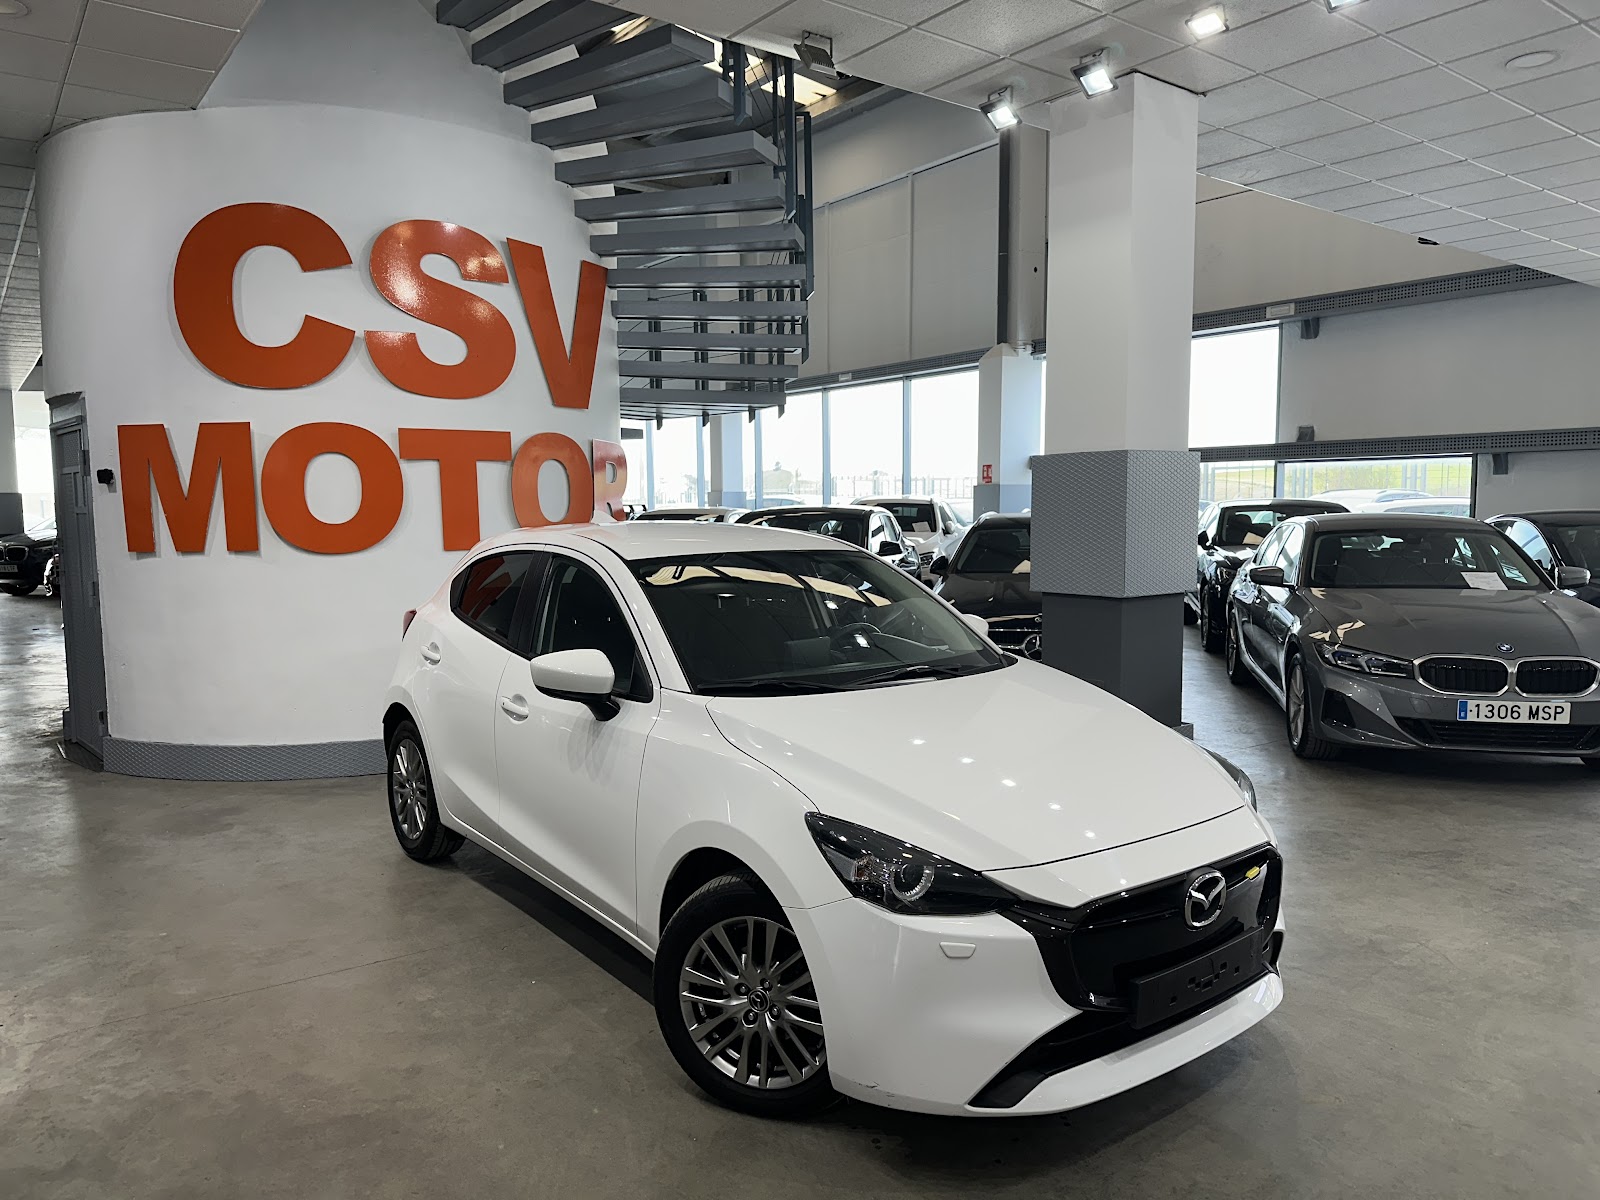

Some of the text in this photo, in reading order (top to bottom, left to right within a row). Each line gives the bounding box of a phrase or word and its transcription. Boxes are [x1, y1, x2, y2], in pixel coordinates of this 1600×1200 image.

[173, 202, 608, 409] CSV
[117, 422, 628, 554] MOTOR
[1474, 703, 1521, 720] 1306
[1528, 705, 1565, 721] MSP
